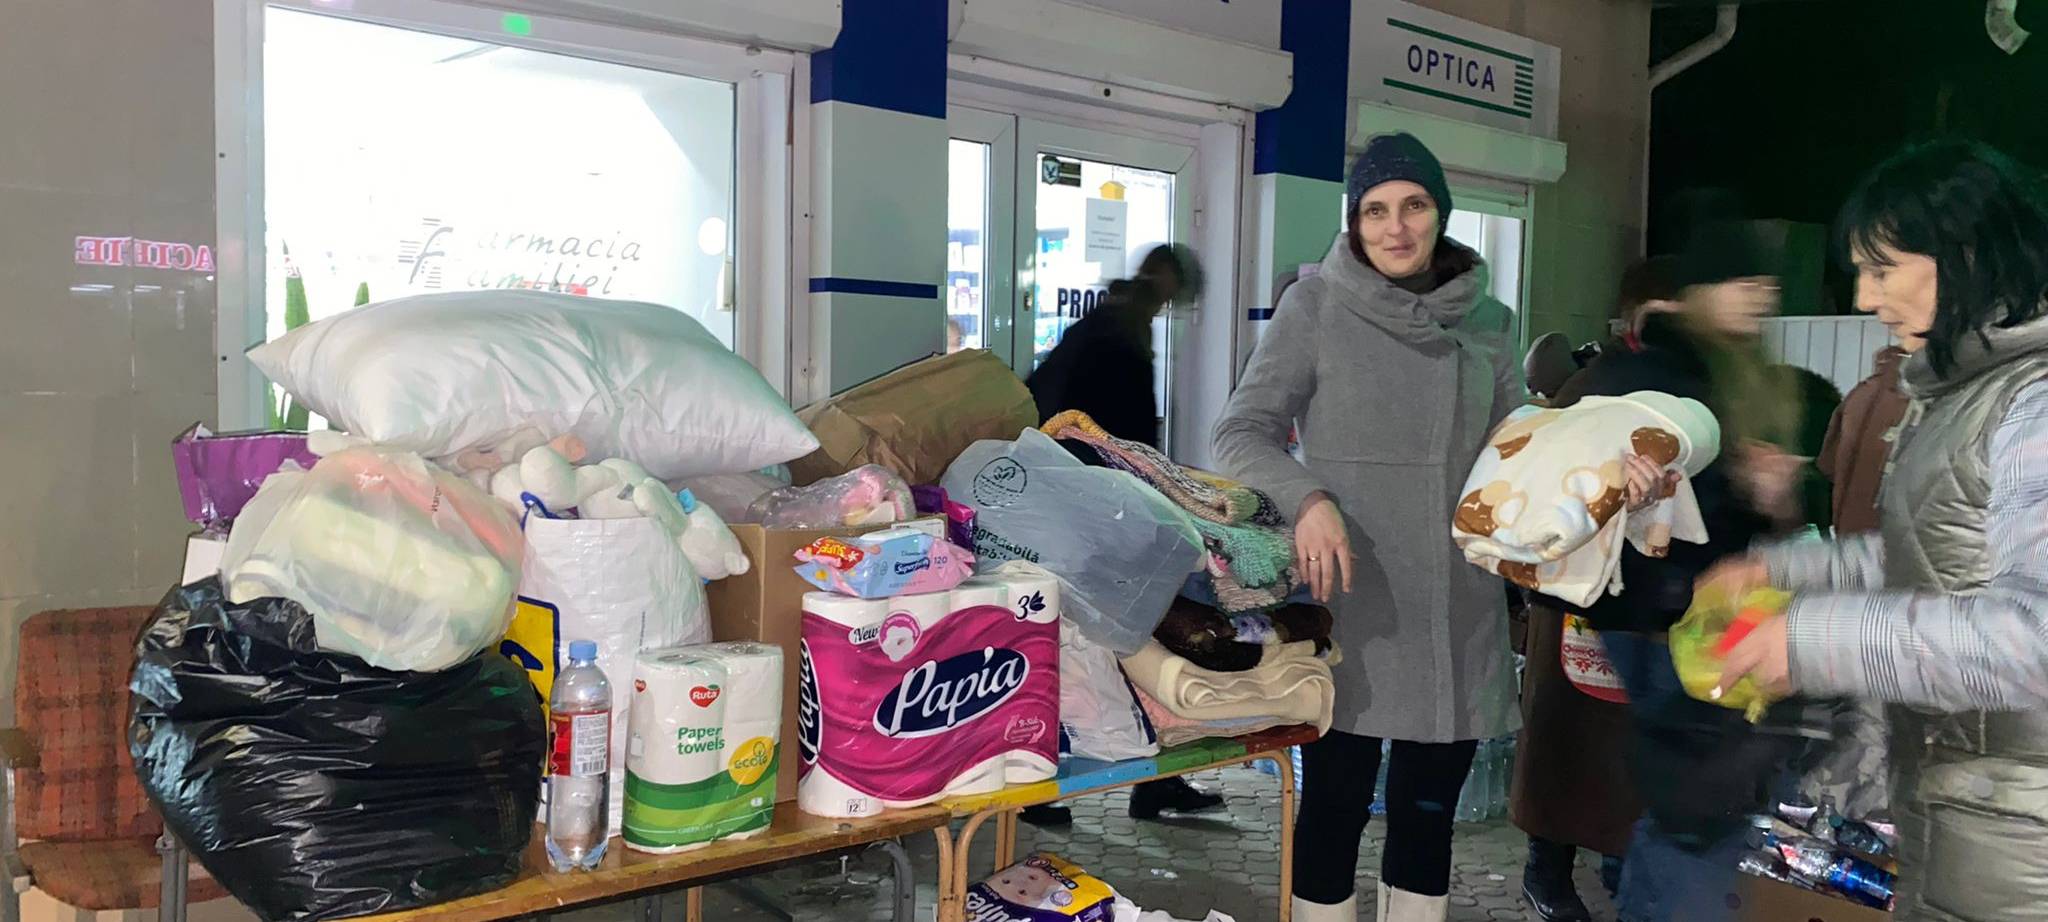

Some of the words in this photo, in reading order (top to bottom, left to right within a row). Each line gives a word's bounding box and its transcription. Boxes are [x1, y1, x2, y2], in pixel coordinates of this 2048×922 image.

[1407, 45, 1496, 93] OPTICA
[934, 556, 948, 565] 120
[1015, 595, 1029, 621] 3
[853, 626, 879, 643] New
[691, 691, 718, 701] Ruta
[888, 646, 1023, 737] Papia
[677, 727, 723, 744] Paper
[676, 737, 725, 755] towels
